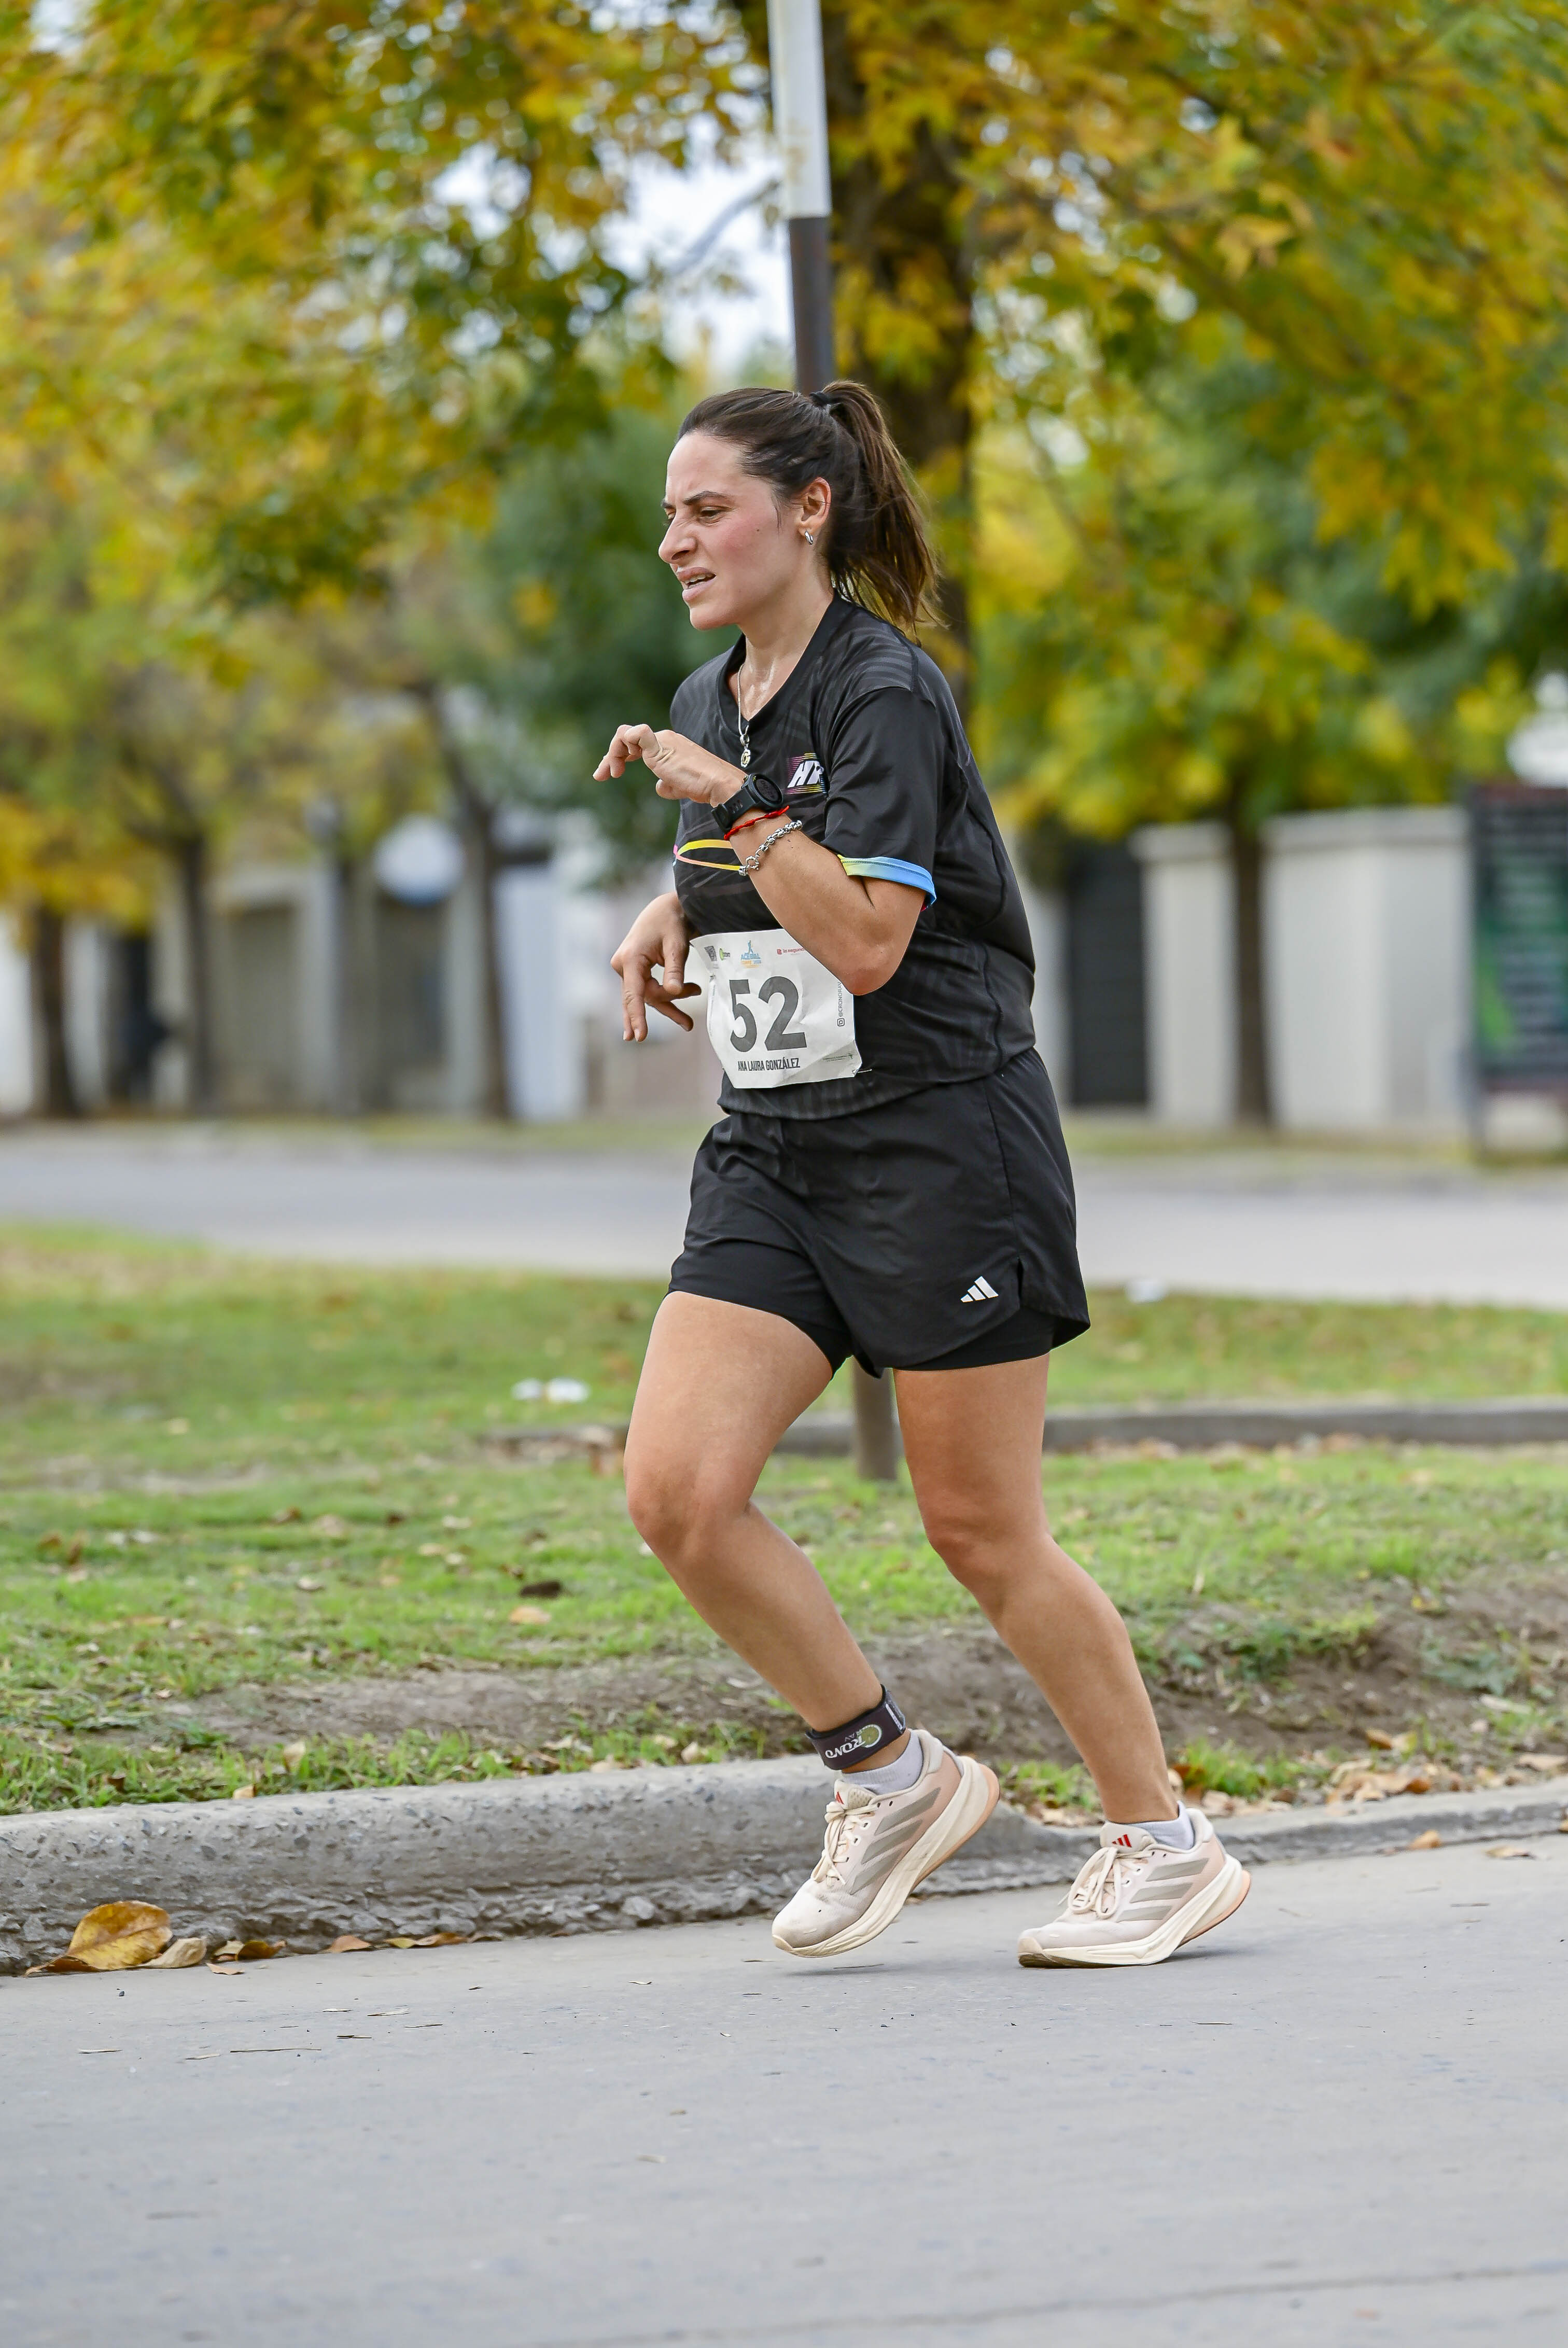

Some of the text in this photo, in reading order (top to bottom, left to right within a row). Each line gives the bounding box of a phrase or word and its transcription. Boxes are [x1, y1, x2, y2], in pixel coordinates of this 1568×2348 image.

[729, 976, 807, 1053] 52
[737, 1057, 801, 1071] ANA LAURA GONZÁLEZ
